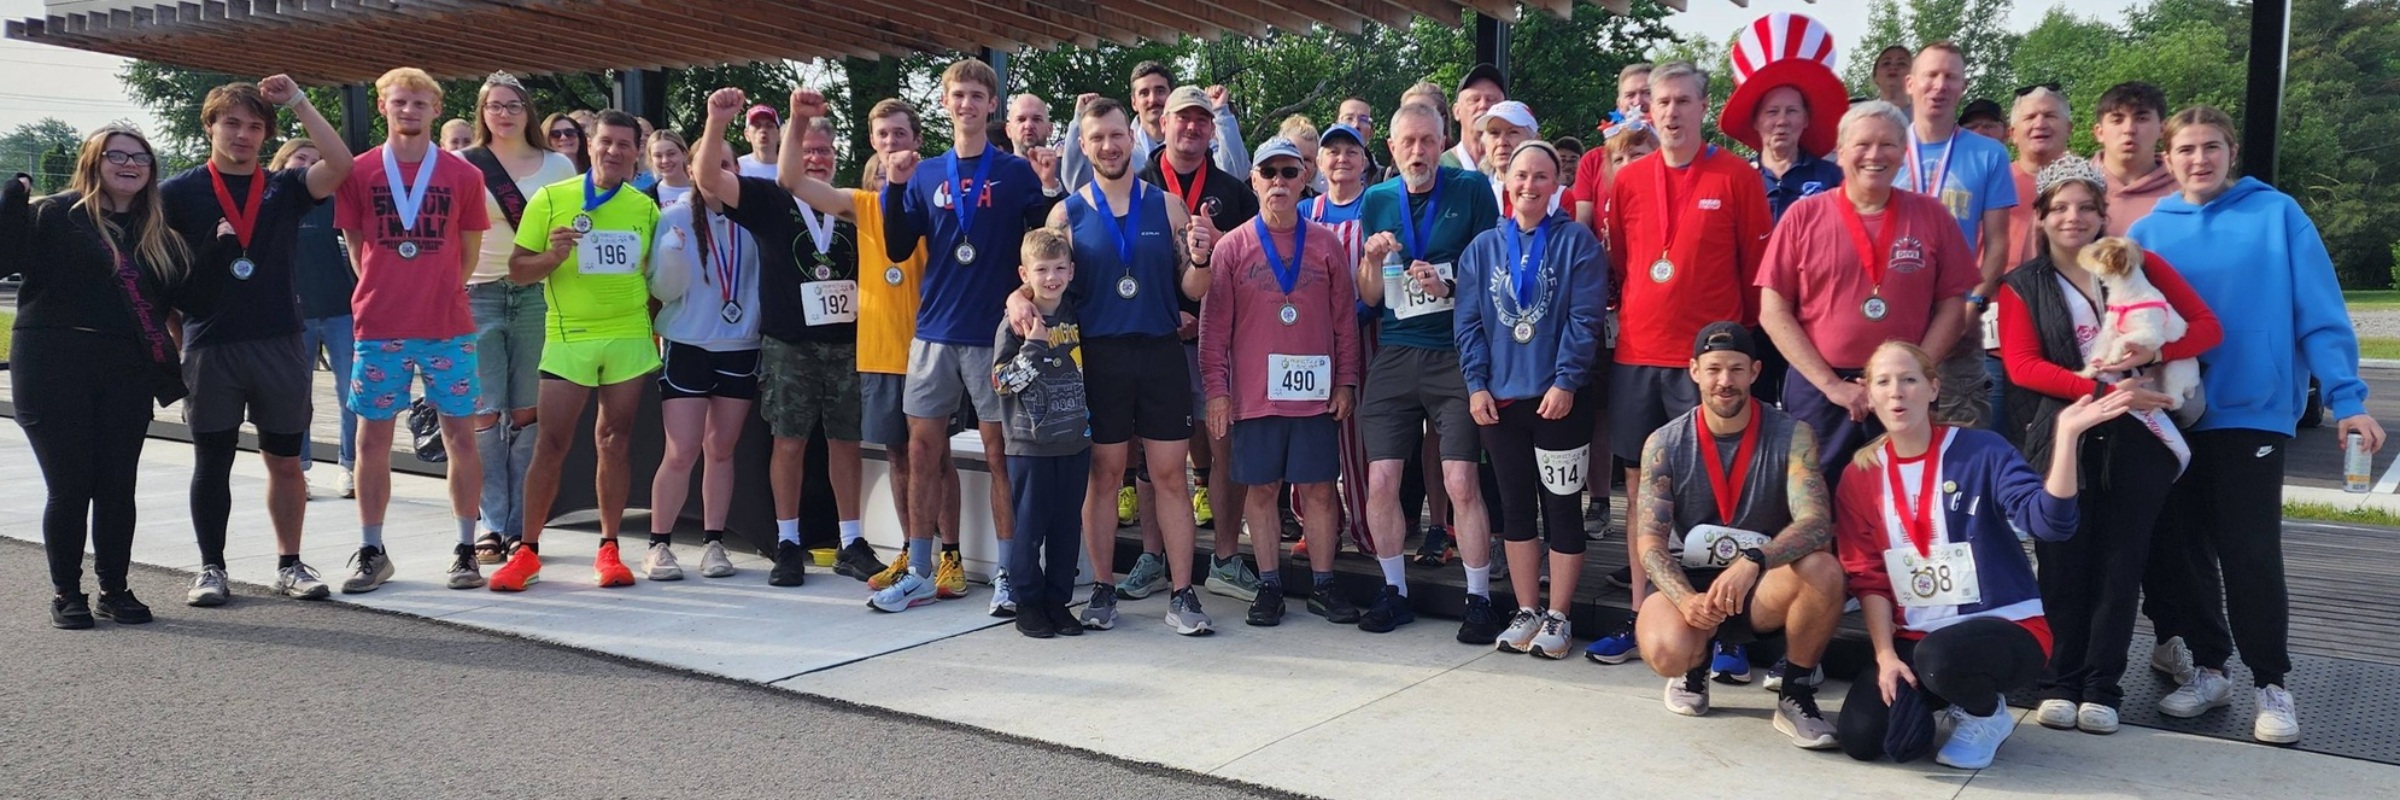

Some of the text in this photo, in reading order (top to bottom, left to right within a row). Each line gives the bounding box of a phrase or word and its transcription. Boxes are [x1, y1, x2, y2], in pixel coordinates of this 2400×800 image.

[594, 244, 627, 265] 196
[1898, 250, 1918, 258] DIVE
[819, 294, 850, 315] 192
[1282, 370, 1315, 391] 490
[1545, 464, 1578, 486] 314
